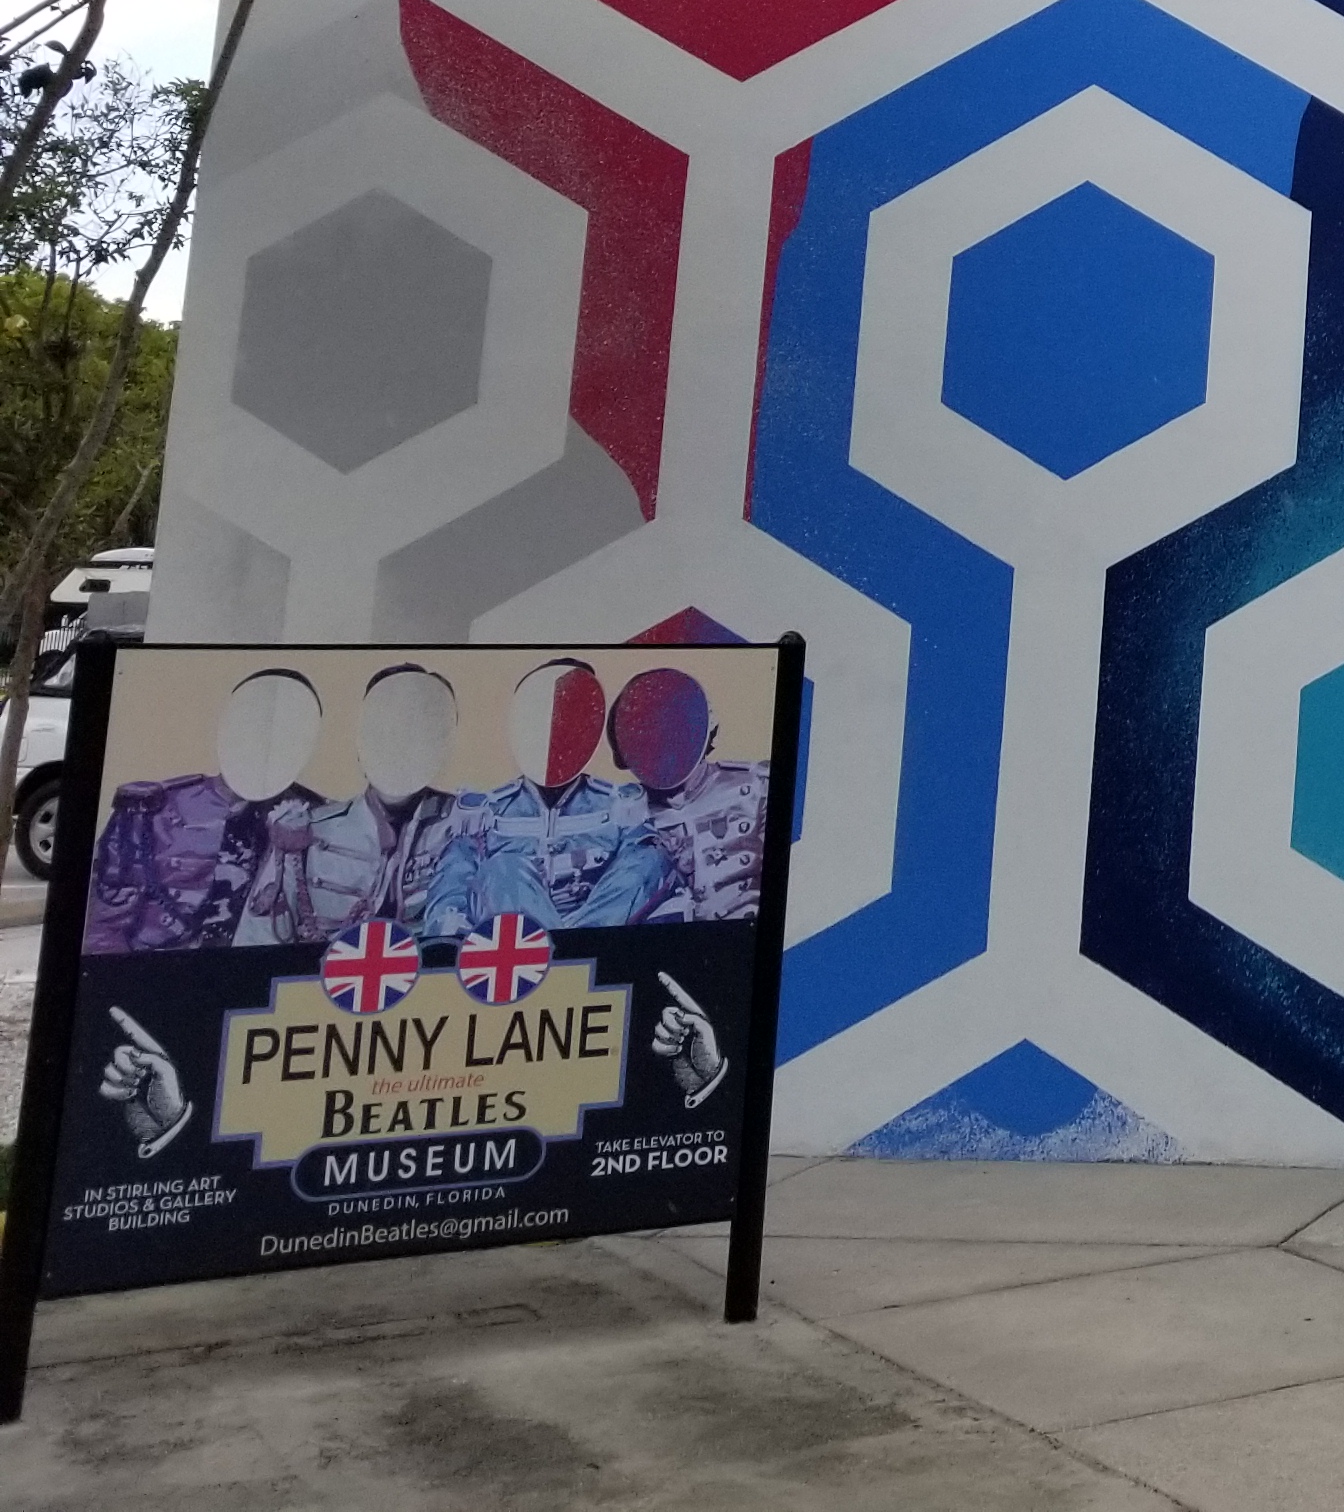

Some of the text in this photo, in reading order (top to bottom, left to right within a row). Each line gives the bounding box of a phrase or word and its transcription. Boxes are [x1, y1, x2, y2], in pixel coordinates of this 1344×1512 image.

[241, 1003, 613, 1085] PENNY LANE
[371, 1071, 485, 1096] the ultimate
[320, 1088, 528, 1139] BEATLES
[595, 1130, 725, 1154] TAKE ELEVATOR TO
[322, 1138, 517, 1187] MUSEUM
[590, 1145, 728, 1177] 2ND FLOOR
[63, 1188, 237, 1221] STUDIOS & GALLERY
[83, 1176, 222, 1203] IN STIRLING ART
[327, 1186, 506, 1217] DUNEDIN, FLORIDA
[108, 1209, 190, 1232] BUILDING
[259, 1206, 570, 1257] DunedinBeatles@gmail.com
